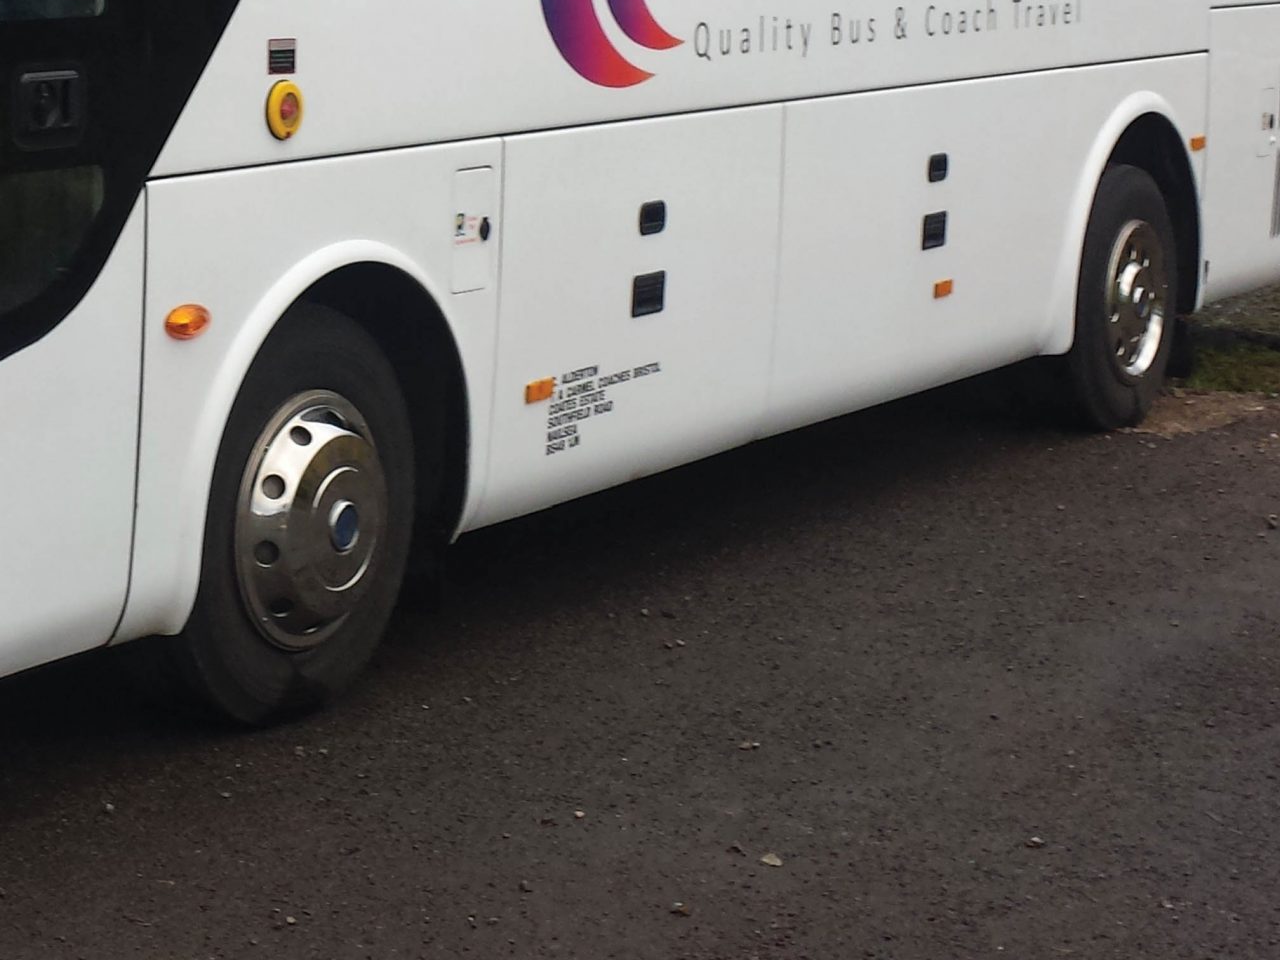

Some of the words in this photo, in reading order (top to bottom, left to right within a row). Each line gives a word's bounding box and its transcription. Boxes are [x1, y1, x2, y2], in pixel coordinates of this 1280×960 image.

[693, 14, 812, 60] Quality
[831, 12, 876, 46] Bus
[894, 6, 908, 39] &
[925, 0, 998, 37] Coach
